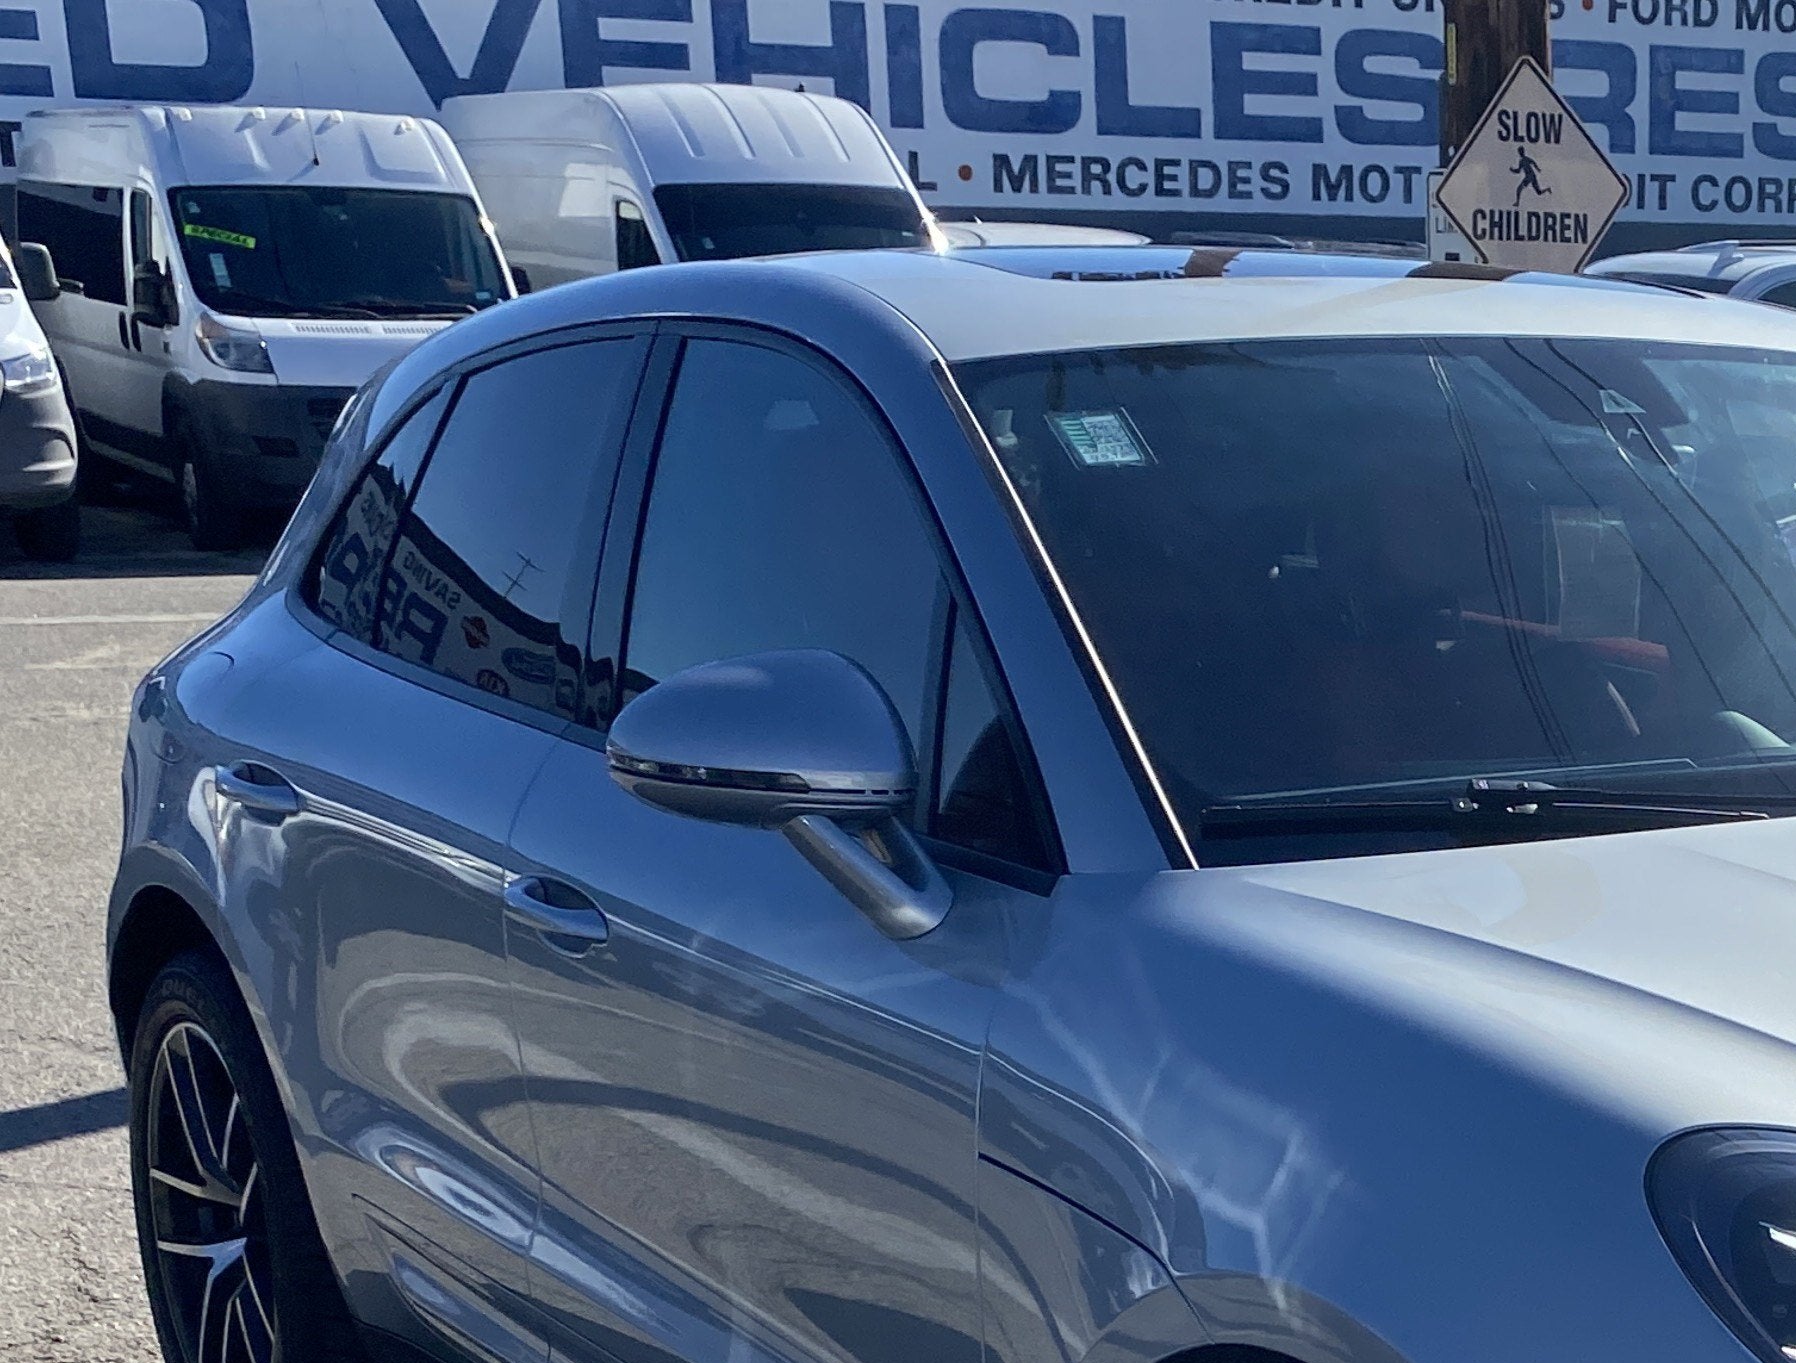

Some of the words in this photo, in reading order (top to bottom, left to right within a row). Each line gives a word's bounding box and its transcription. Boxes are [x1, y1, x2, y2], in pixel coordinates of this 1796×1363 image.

[1607, 0, 1719, 28] FORD
[380, 0, 1444, 147] VEHICLES
[1497, 109, 1563, 145] SLOW
[992, 152, 1290, 202] MERCEDES
[1311, 162, 1421, 205] MOT
[1472, 208, 1588, 244] CHILDREN
